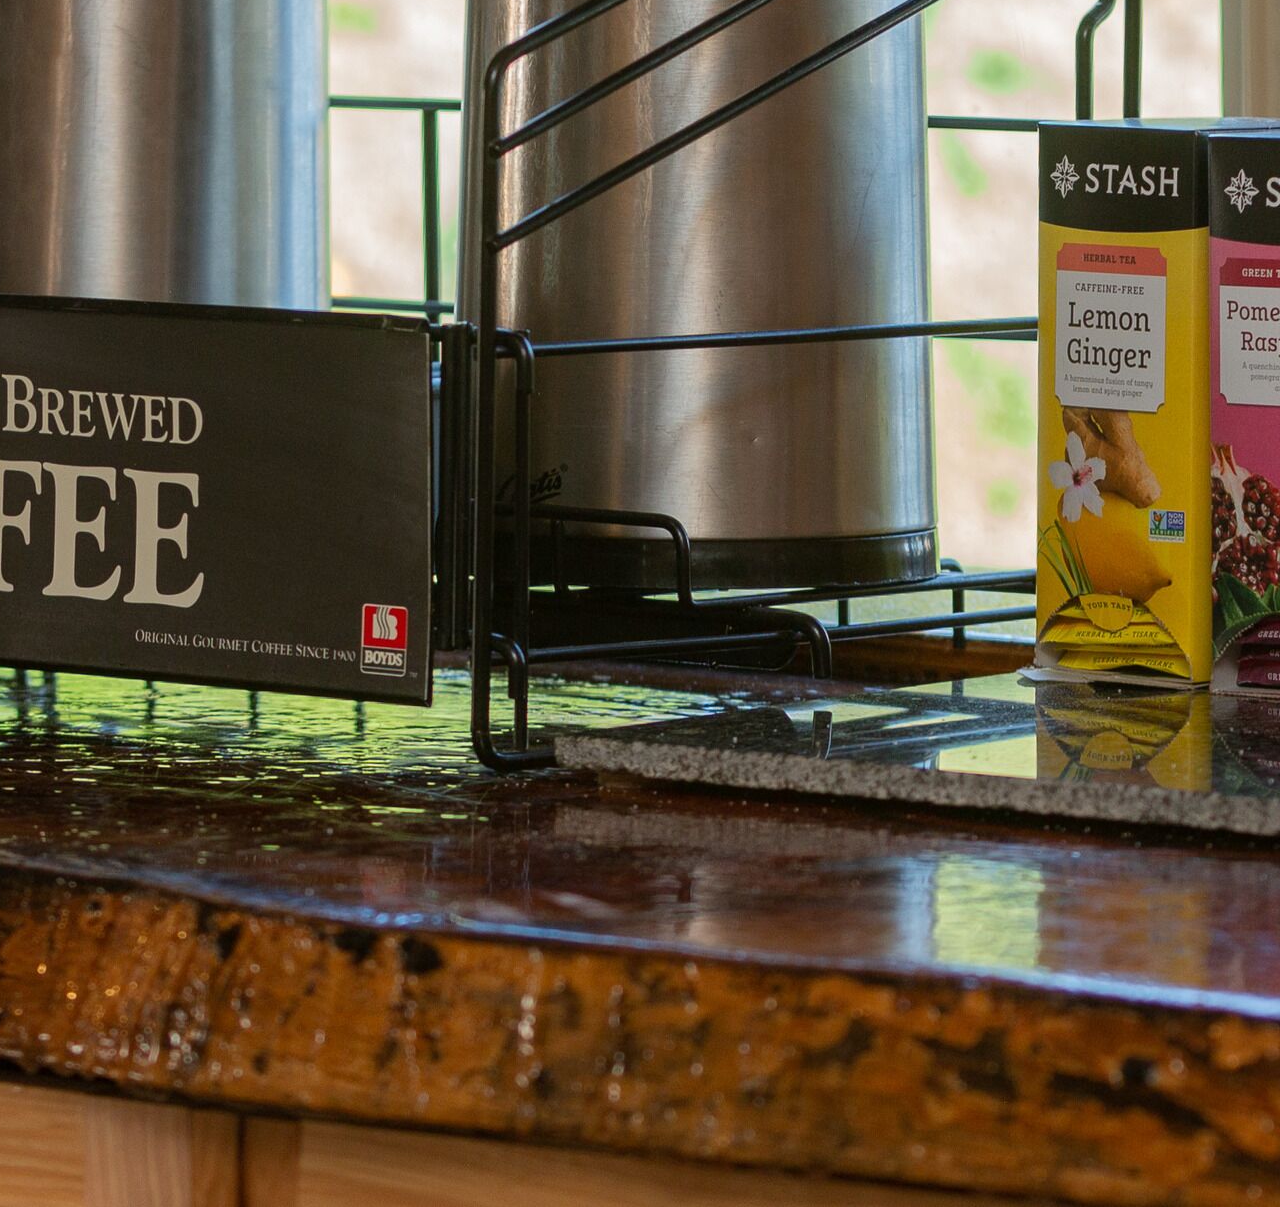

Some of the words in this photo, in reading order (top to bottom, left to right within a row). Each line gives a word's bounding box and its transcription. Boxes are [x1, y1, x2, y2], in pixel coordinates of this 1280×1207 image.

[1084, 163, 1180, 197] STASH
[1083, 253, 1117, 264] HERBAL
[1120, 255, 1137, 265] TEA
[1242, 268, 1273, 278] GREEN
[1075, 282, 1145, 295] CAFFEINE-FREE
[1068, 301, 1151, 332] Lemon
[1067, 337, 1151, 374] Ginger
[1242, 361, 1248, 370] A
[1, 374, 203, 445] BREWED
[1087, 601, 1108, 610] YOUR
[135, 629, 190, 647] ORIGINAL
[192, 634, 249, 653] GOURMET
[251, 639, 293, 656] COFFEE
[295, 643, 329, 660] SINCE
[332, 649, 356, 662] 1900
[364, 650, 403, 666] BOYDS
